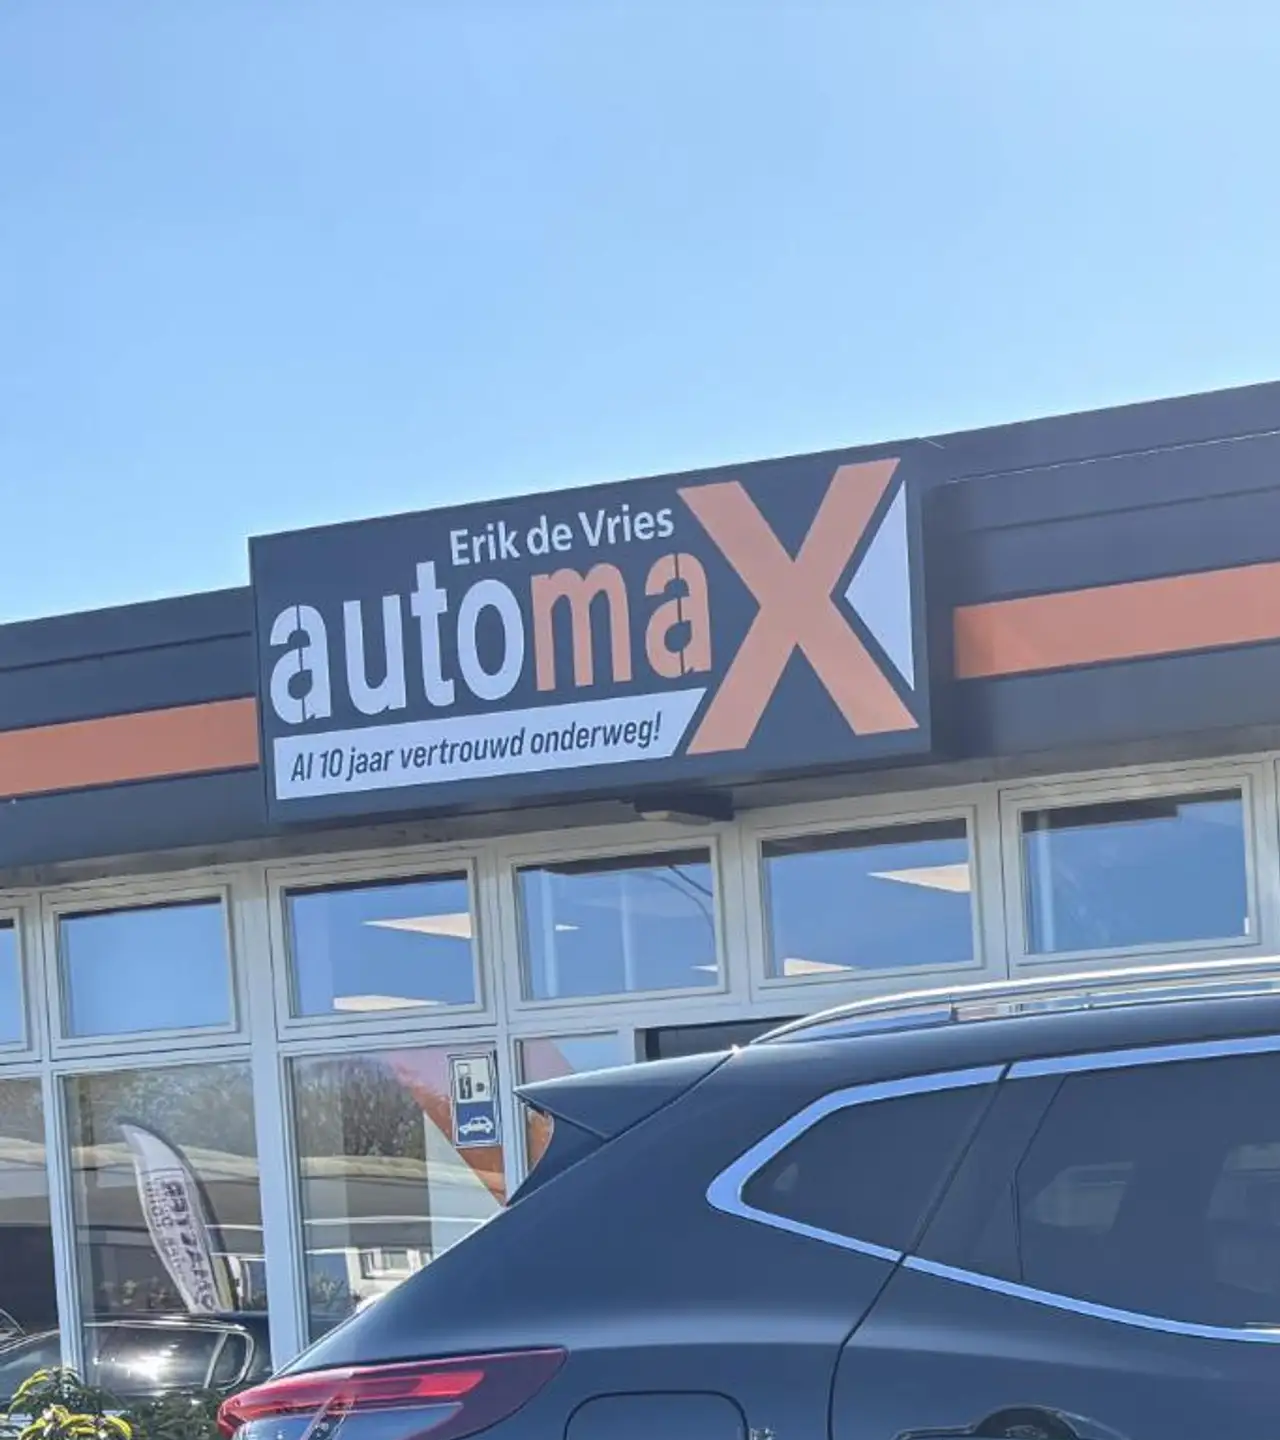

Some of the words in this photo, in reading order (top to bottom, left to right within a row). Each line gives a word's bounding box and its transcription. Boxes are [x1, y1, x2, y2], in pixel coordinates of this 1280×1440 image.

[450, 521, 520, 566] Erik
[527, 515, 573, 555] de
[578, 504, 674, 547] Vries
[320, 748, 344, 778] 10
[345, 746, 394, 781] jaar
[401, 727, 526, 770] vertrouwd
[530, 711, 662, 755] onderweg!
